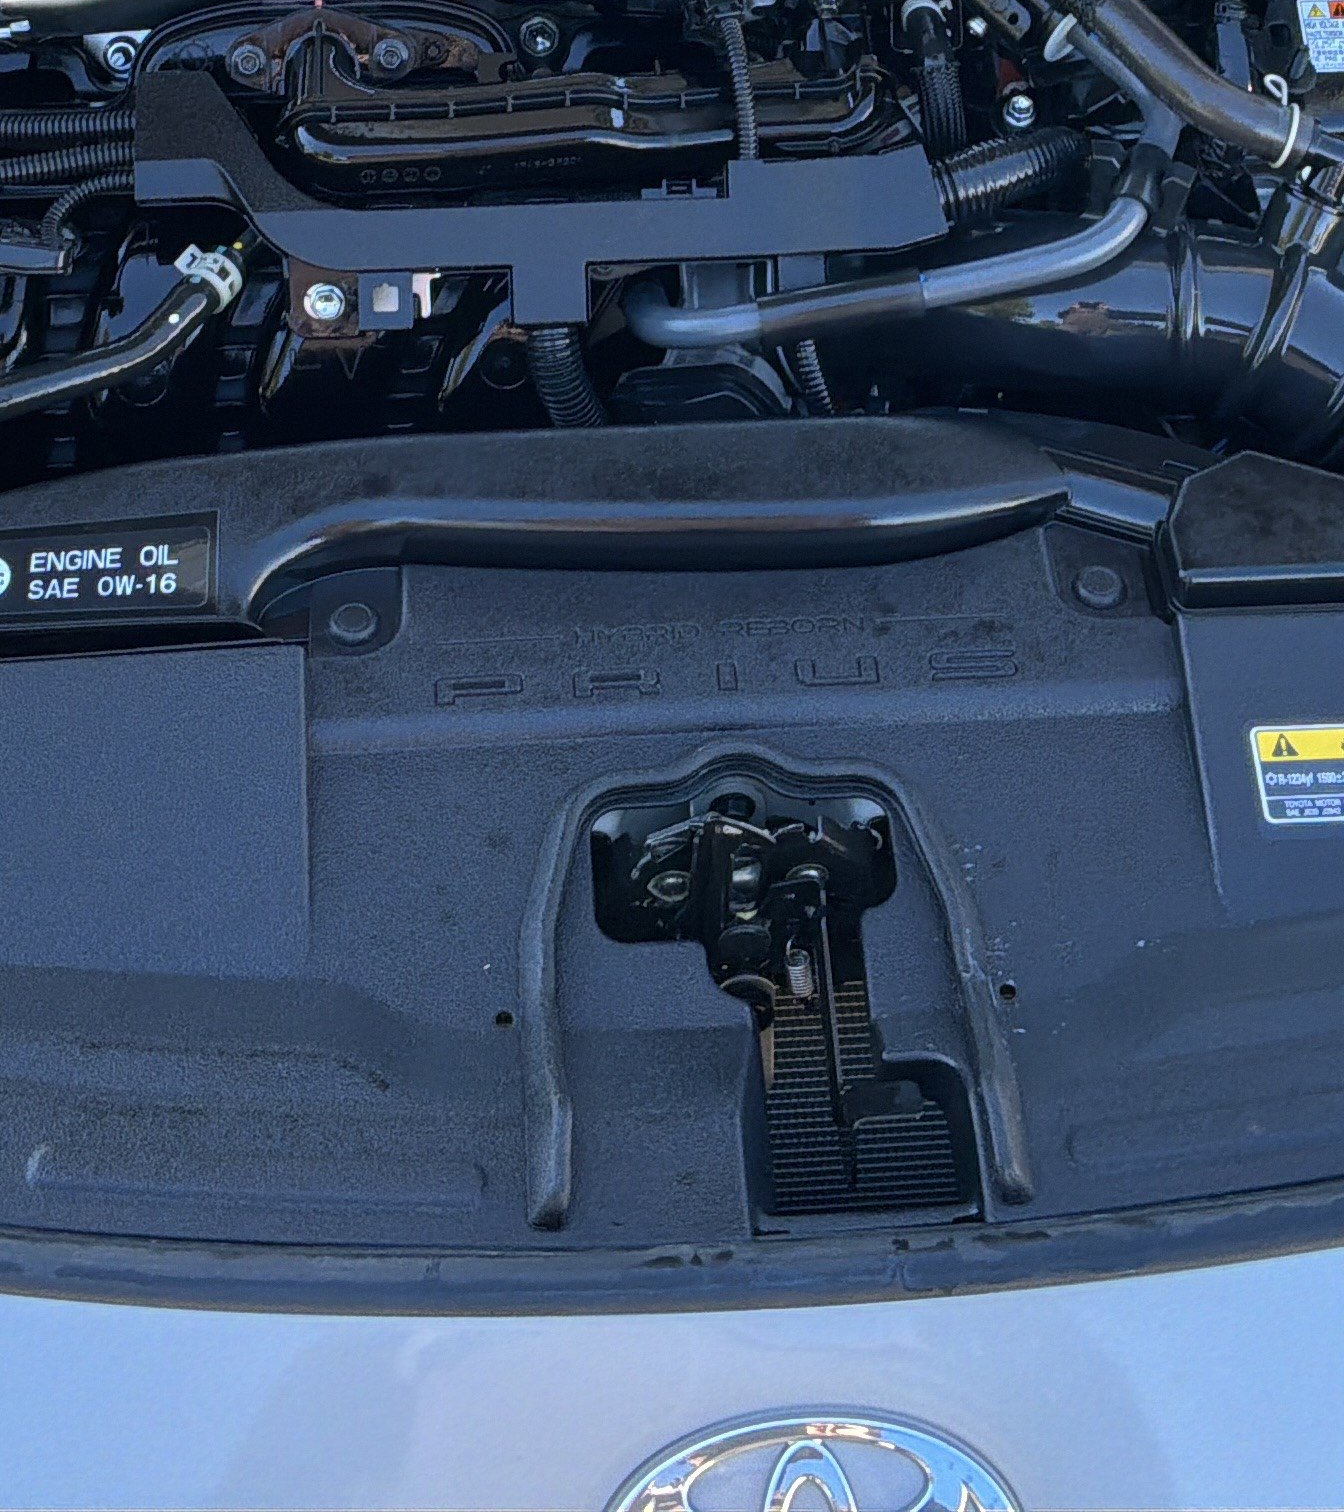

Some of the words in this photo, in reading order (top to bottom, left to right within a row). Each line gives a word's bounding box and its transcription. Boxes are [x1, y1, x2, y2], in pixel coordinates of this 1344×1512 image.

[29, 546, 124, 574] ENGINE
[139, 543, 179, 567] OIL
[27, 577, 81, 601] SAE
[96, 572, 178, 597] 0W-16
[573, 622, 701, 645] HYBRID
[716, 616, 865, 637] REBORN
[434, 648, 1019, 706] PRIUS
[1284, 799, 1313, 808] TOYOTA
[1315, 798, 1342, 807] MOTOR
